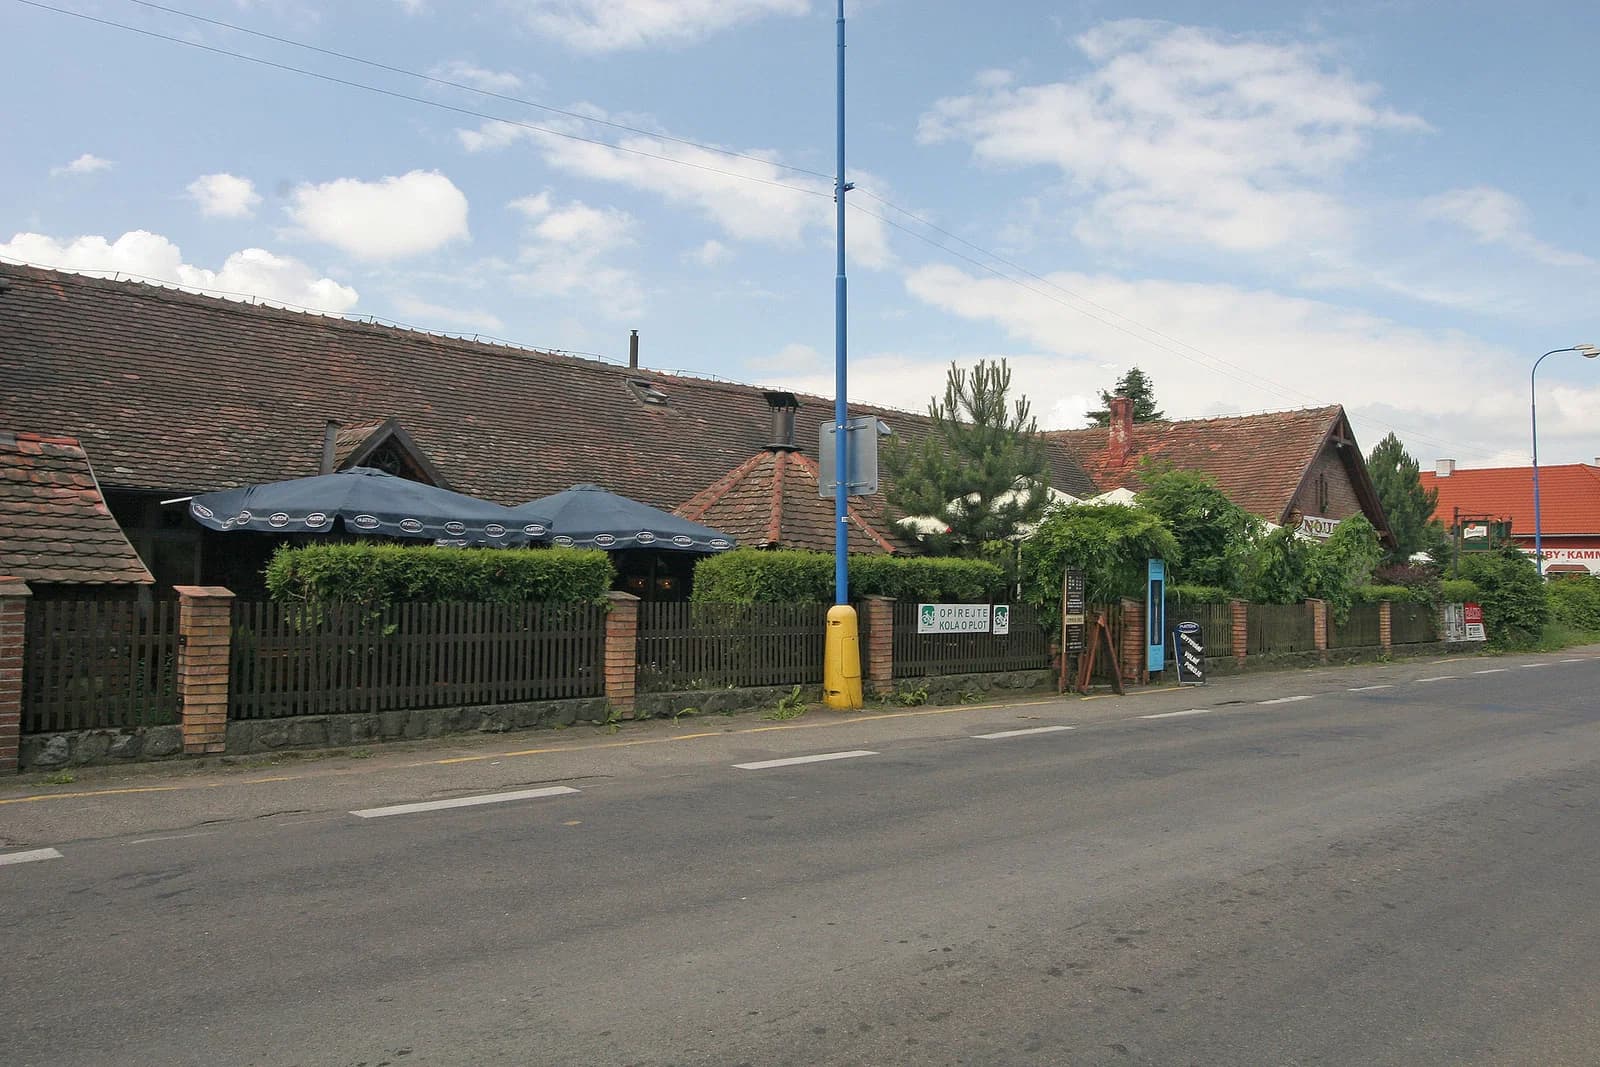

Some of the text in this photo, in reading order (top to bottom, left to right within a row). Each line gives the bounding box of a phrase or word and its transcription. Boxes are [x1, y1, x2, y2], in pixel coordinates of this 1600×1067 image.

[939, 621, 987, 630] KOLA O PLOT
